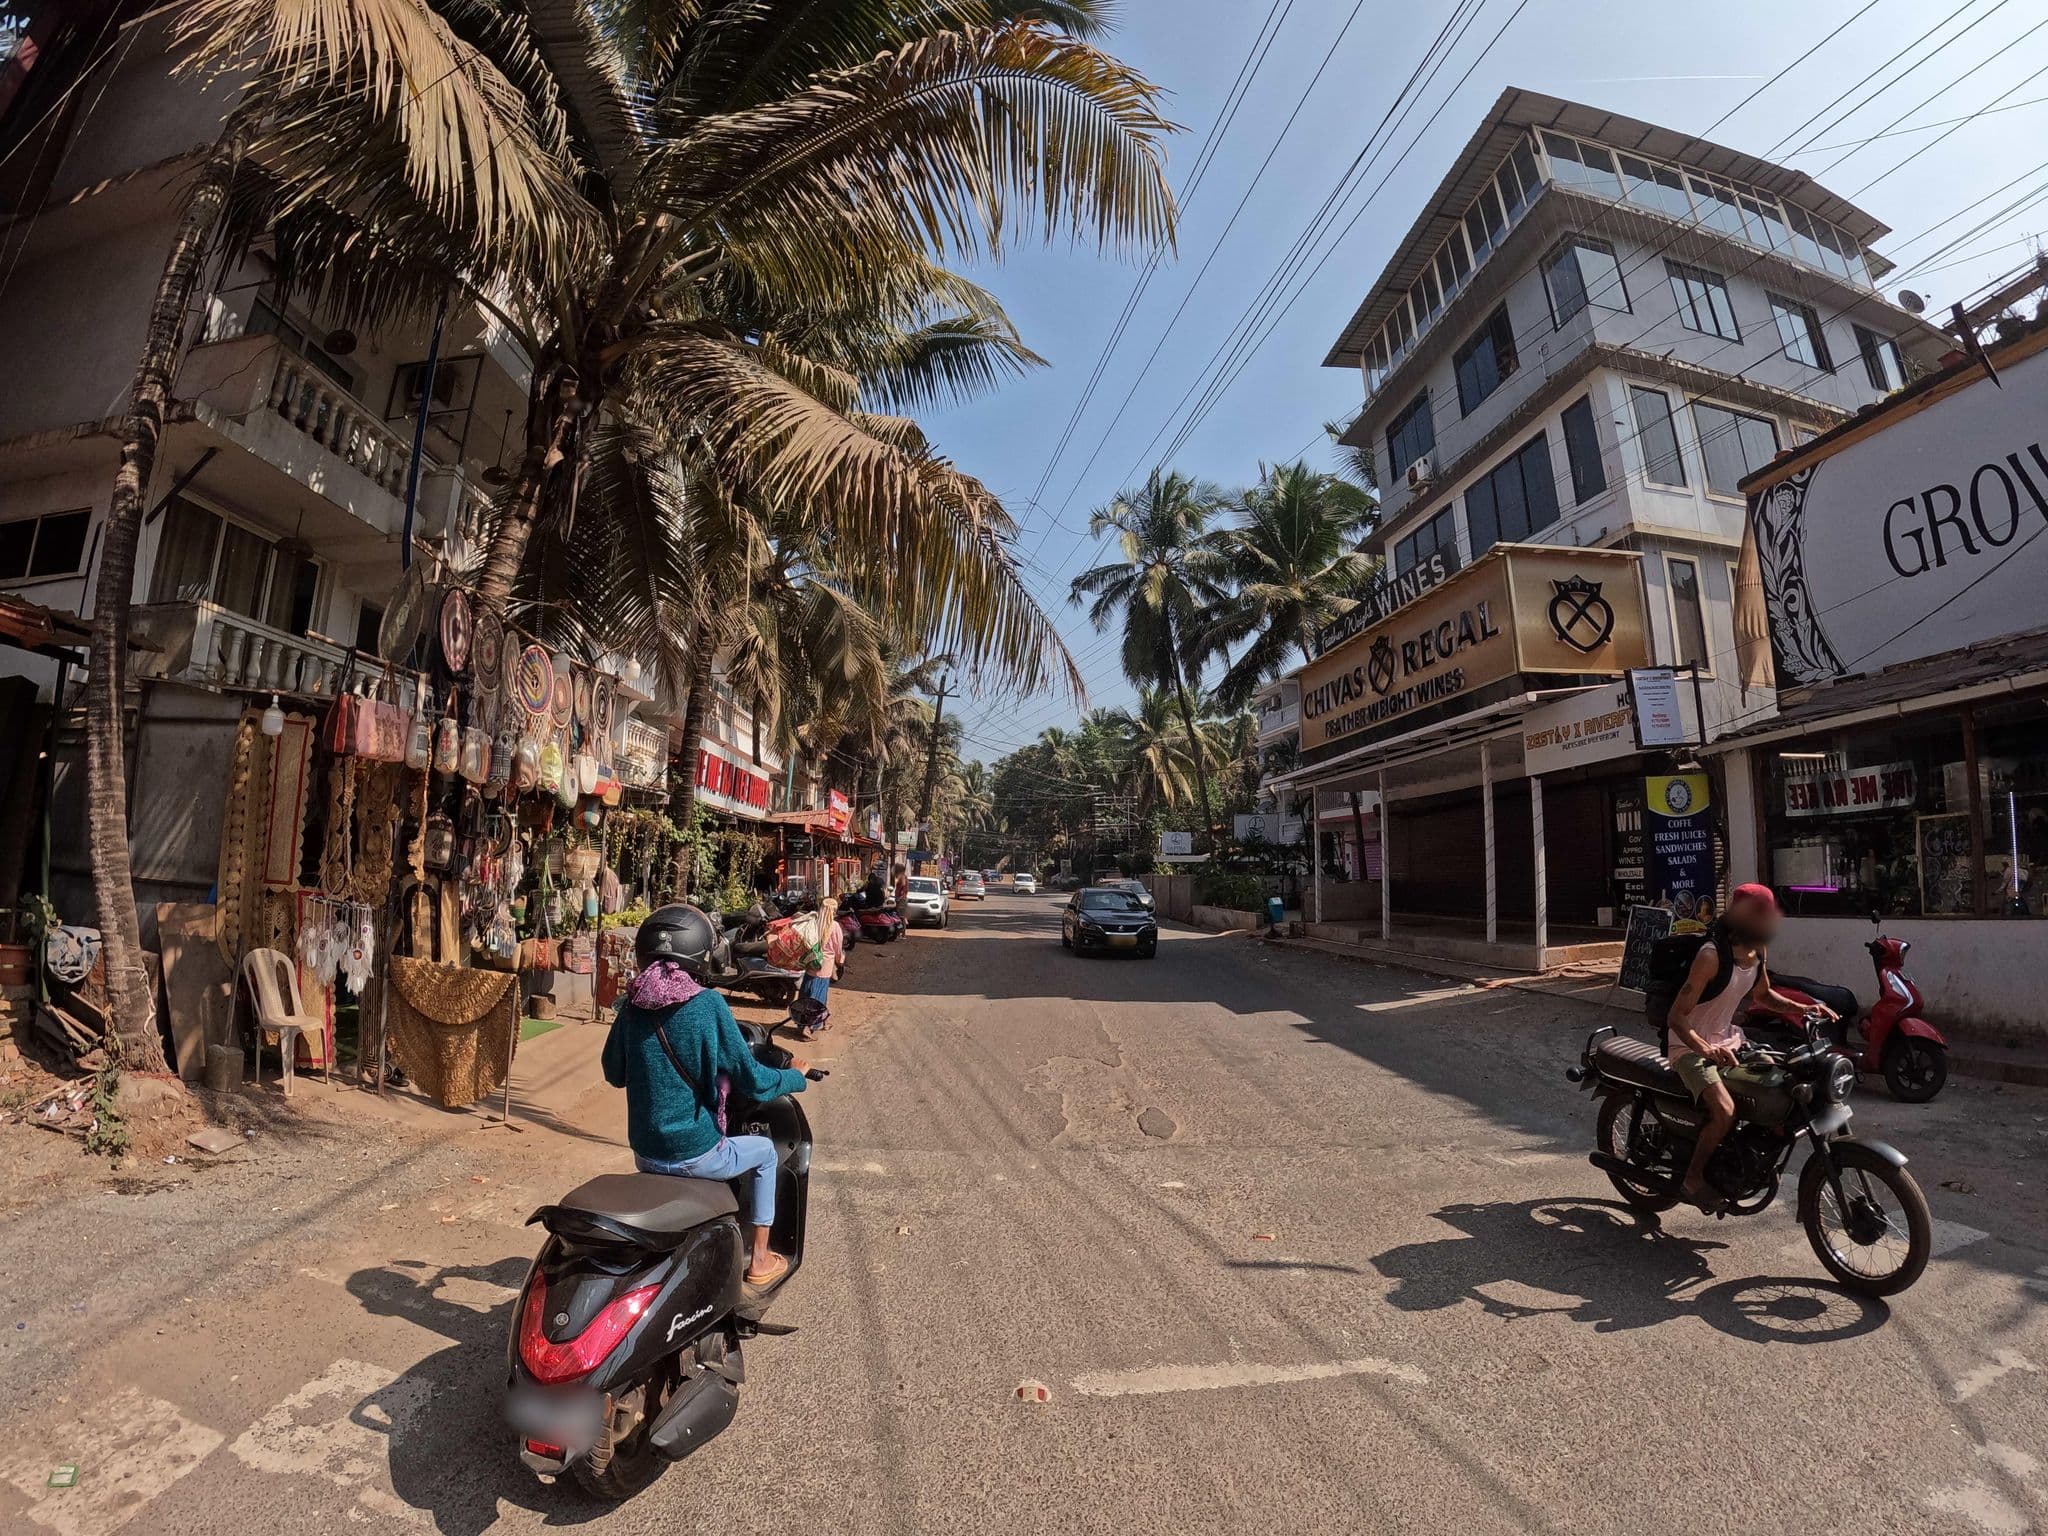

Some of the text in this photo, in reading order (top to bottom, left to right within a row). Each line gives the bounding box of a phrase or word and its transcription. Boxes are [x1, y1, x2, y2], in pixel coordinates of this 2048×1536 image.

[1375, 554, 1446, 618] WINES
[1304, 602, 1501, 719] CHIVAS REGAL
[1325, 667, 1465, 738] FEATHER WEIGHT WINES
[1667, 819, 1692, 829] COFFE
[1654, 830, 1707, 841] FRESH JUICES
[1655, 842, 1707, 854] SANDWICHES
[1667, 854, 1697, 866] SALADS
[1680, 868, 1687, 877] &
[1672, 880, 1696, 889] MORE
